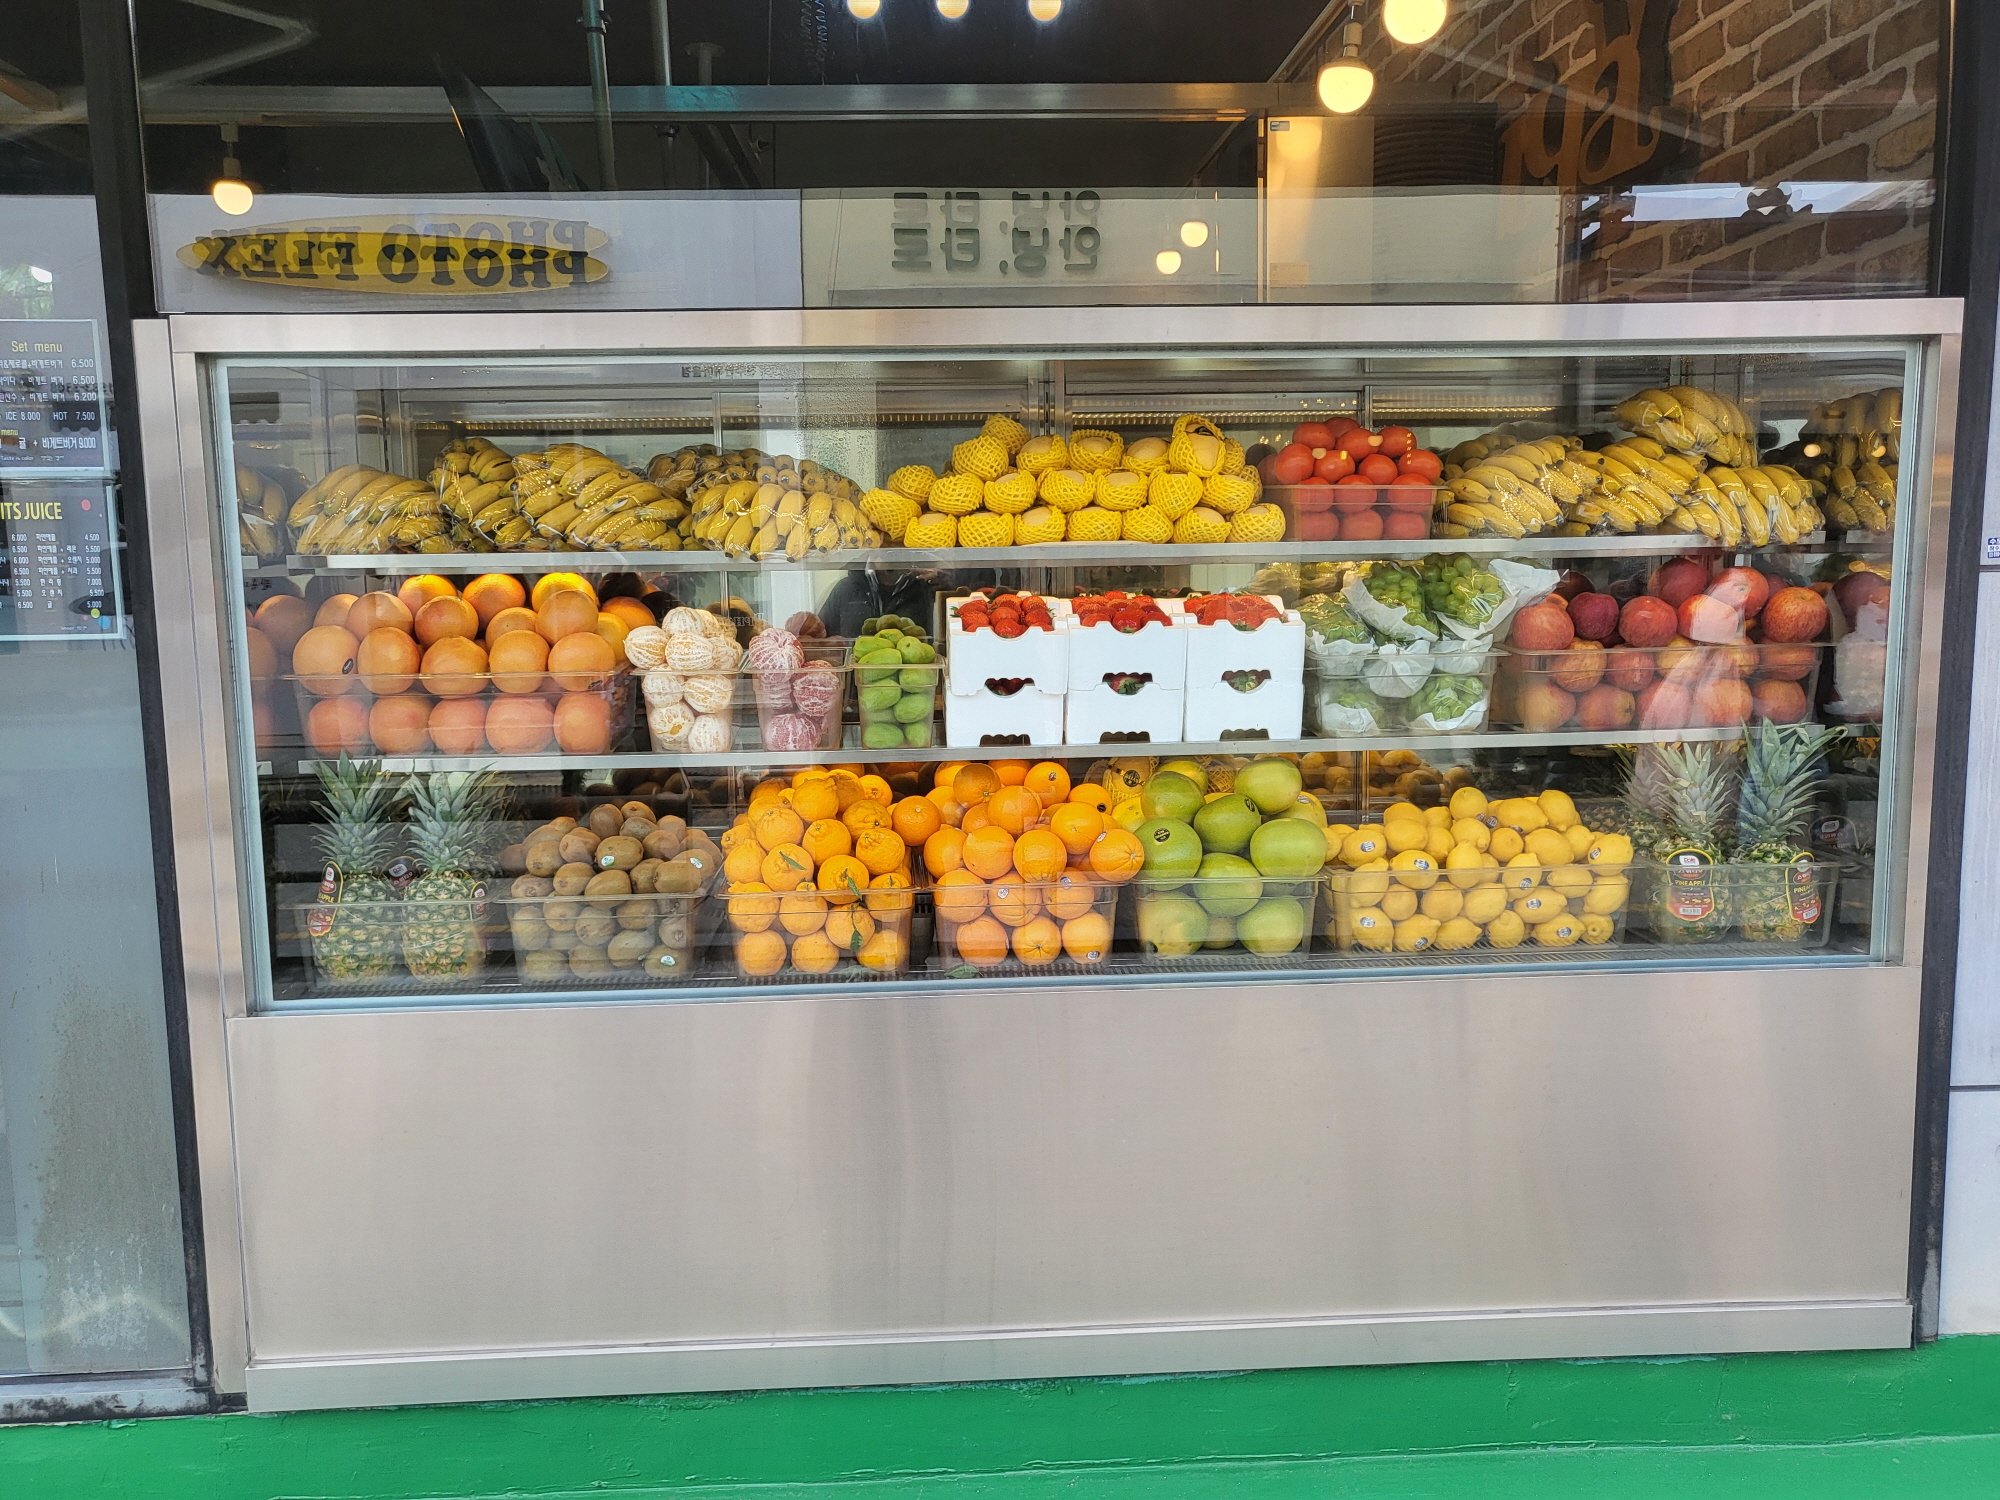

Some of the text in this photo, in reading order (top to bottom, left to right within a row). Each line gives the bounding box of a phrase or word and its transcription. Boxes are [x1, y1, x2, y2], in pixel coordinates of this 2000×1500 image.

[11, 340, 63, 352] Set menu
[71, 359, 94, 368] 6.500
[72, 375, 96, 385] 6.500
[74, 392, 97, 401] 6.200
[5, 411, 96, 421] ICE 8.000 HOT 7.500
[78, 437, 96, 449] 9.000
[23, 502, 63, 520] JUICE
[84, 533, 100, 542] 4.500
[85, 556, 101, 564] 5.000
[15, 578, 31, 586] 5.500
[87, 578, 102, 586] 7.000
[16, 589, 33, 597] 5.500
[1674, 878, 1706, 887] PINEAPPLE
